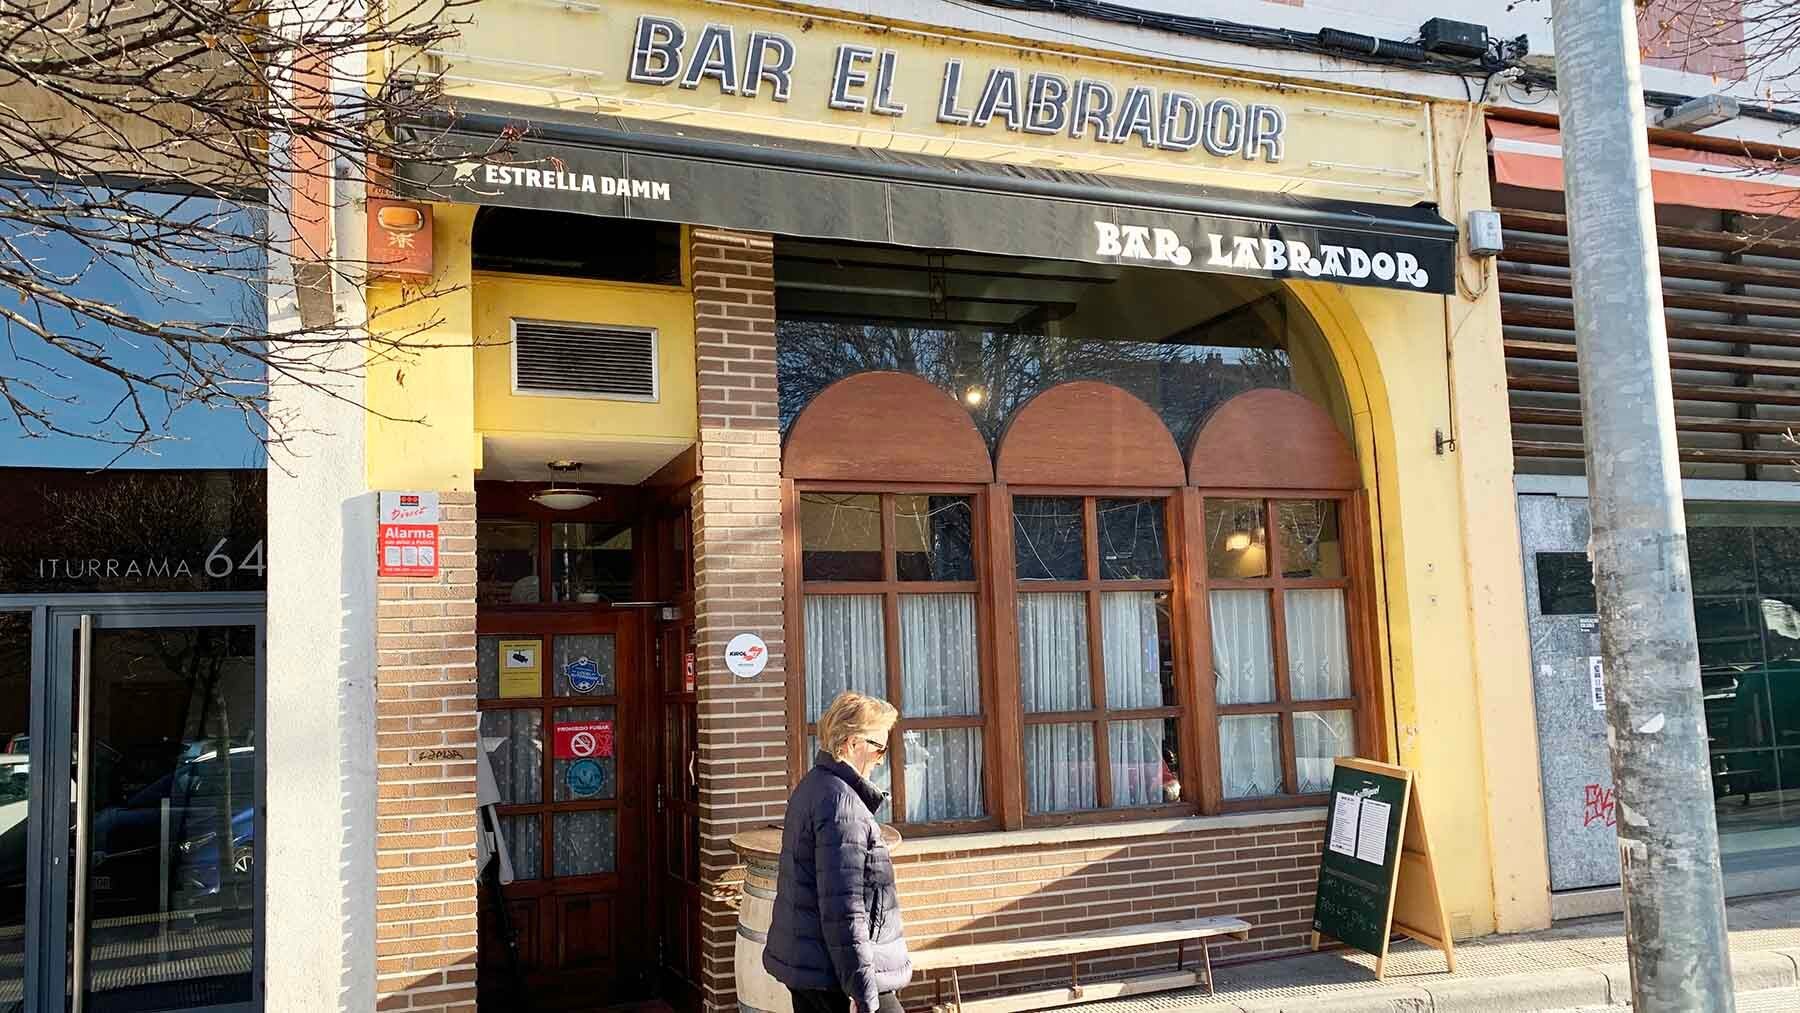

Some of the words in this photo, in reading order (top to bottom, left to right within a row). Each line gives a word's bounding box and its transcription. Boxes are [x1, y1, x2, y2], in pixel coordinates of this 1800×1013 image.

[628, 15, 796, 102] BAR
[828, 43, 908, 118] EL
[935, 57, 1287, 163] LABRADOR
[485, 164, 597, 194] ESTRELLA
[600, 175, 671, 201] DAMM
[1093, 220, 1193, 266] BAR
[1206, 231, 1430, 289] LABRADOR
[385, 527, 434, 538] Alarma
[38, 557, 193, 579] ITURRAMA
[203, 537, 267, 578] 64
